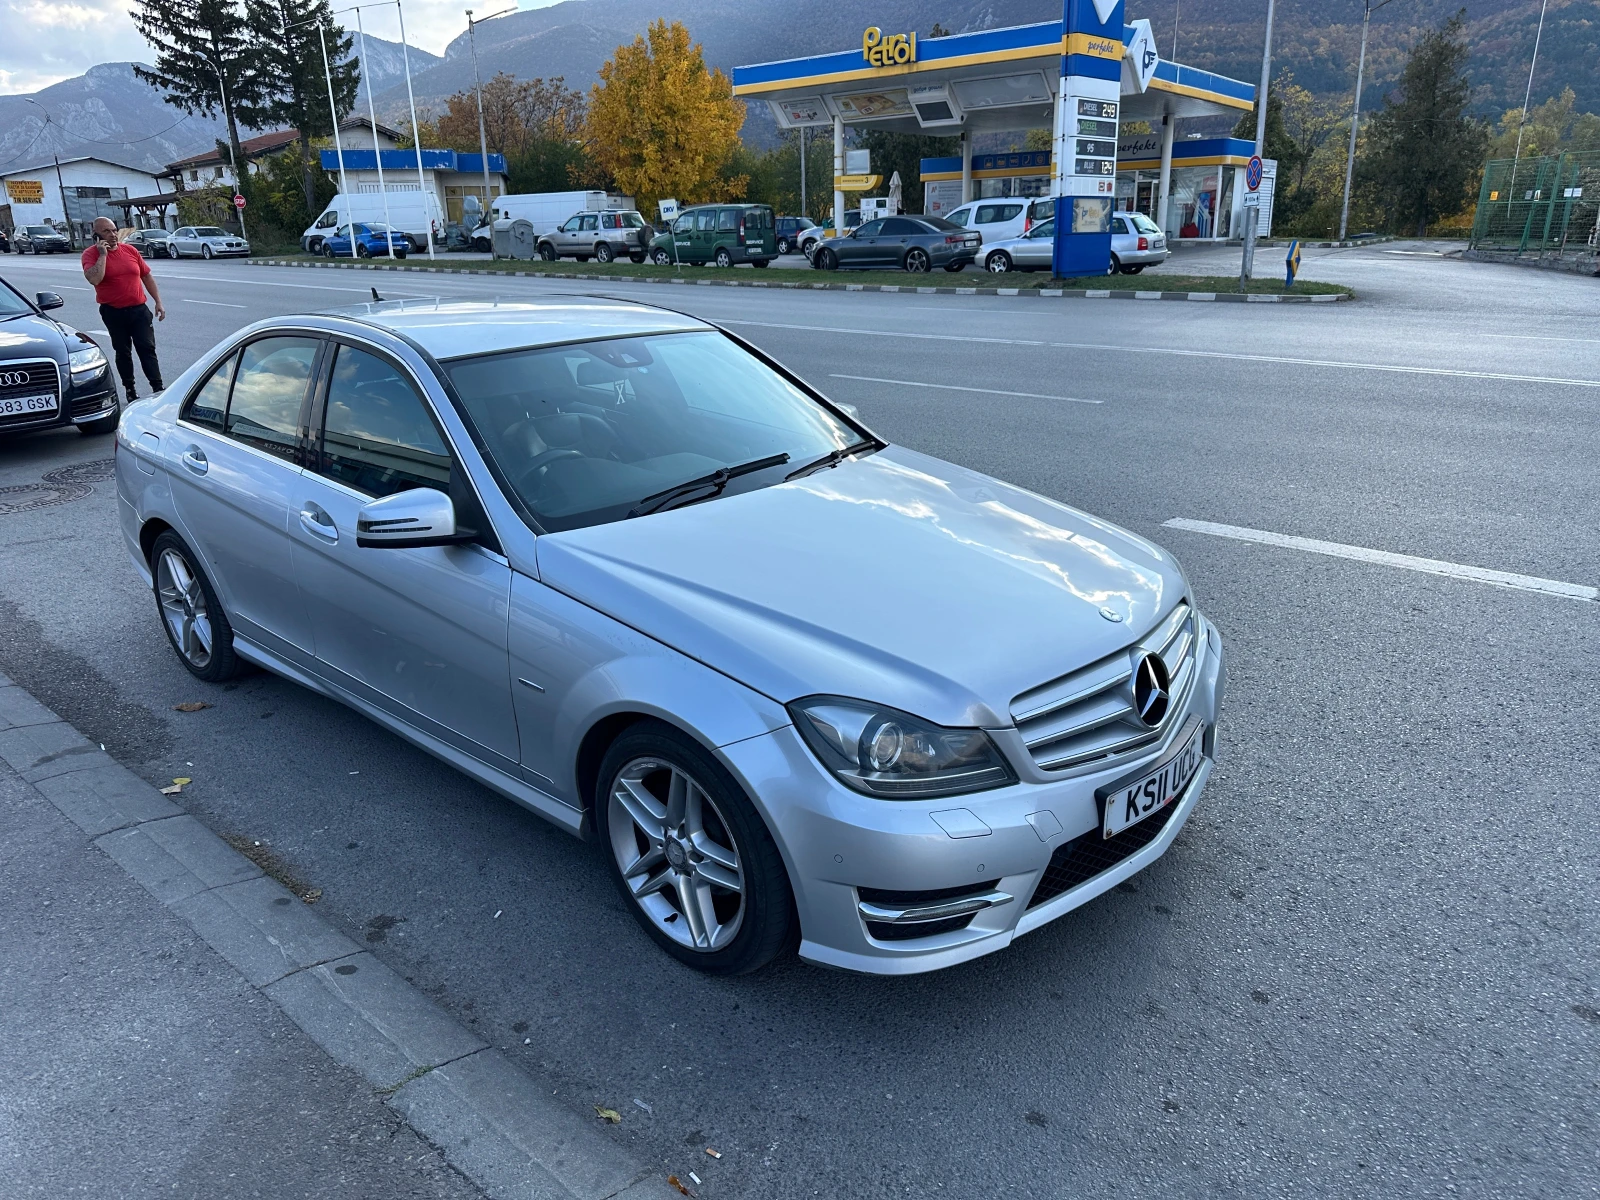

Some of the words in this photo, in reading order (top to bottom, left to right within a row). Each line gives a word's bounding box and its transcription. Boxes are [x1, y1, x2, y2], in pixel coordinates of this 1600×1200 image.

[863, 26, 918, 67] Petrol
[1087, 41, 1114, 55] perfekt
[1083, 102, 1098, 112] DIESEL
[1080, 121, 1097, 131] DIESEL
[1086, 143, 1095, 153] 95
[864, 176, 869, 184] 3
[663, 206, 675, 214] DKV
[27, 396, 54, 410] GSK
[1172, 738, 1196, 792] UCG
